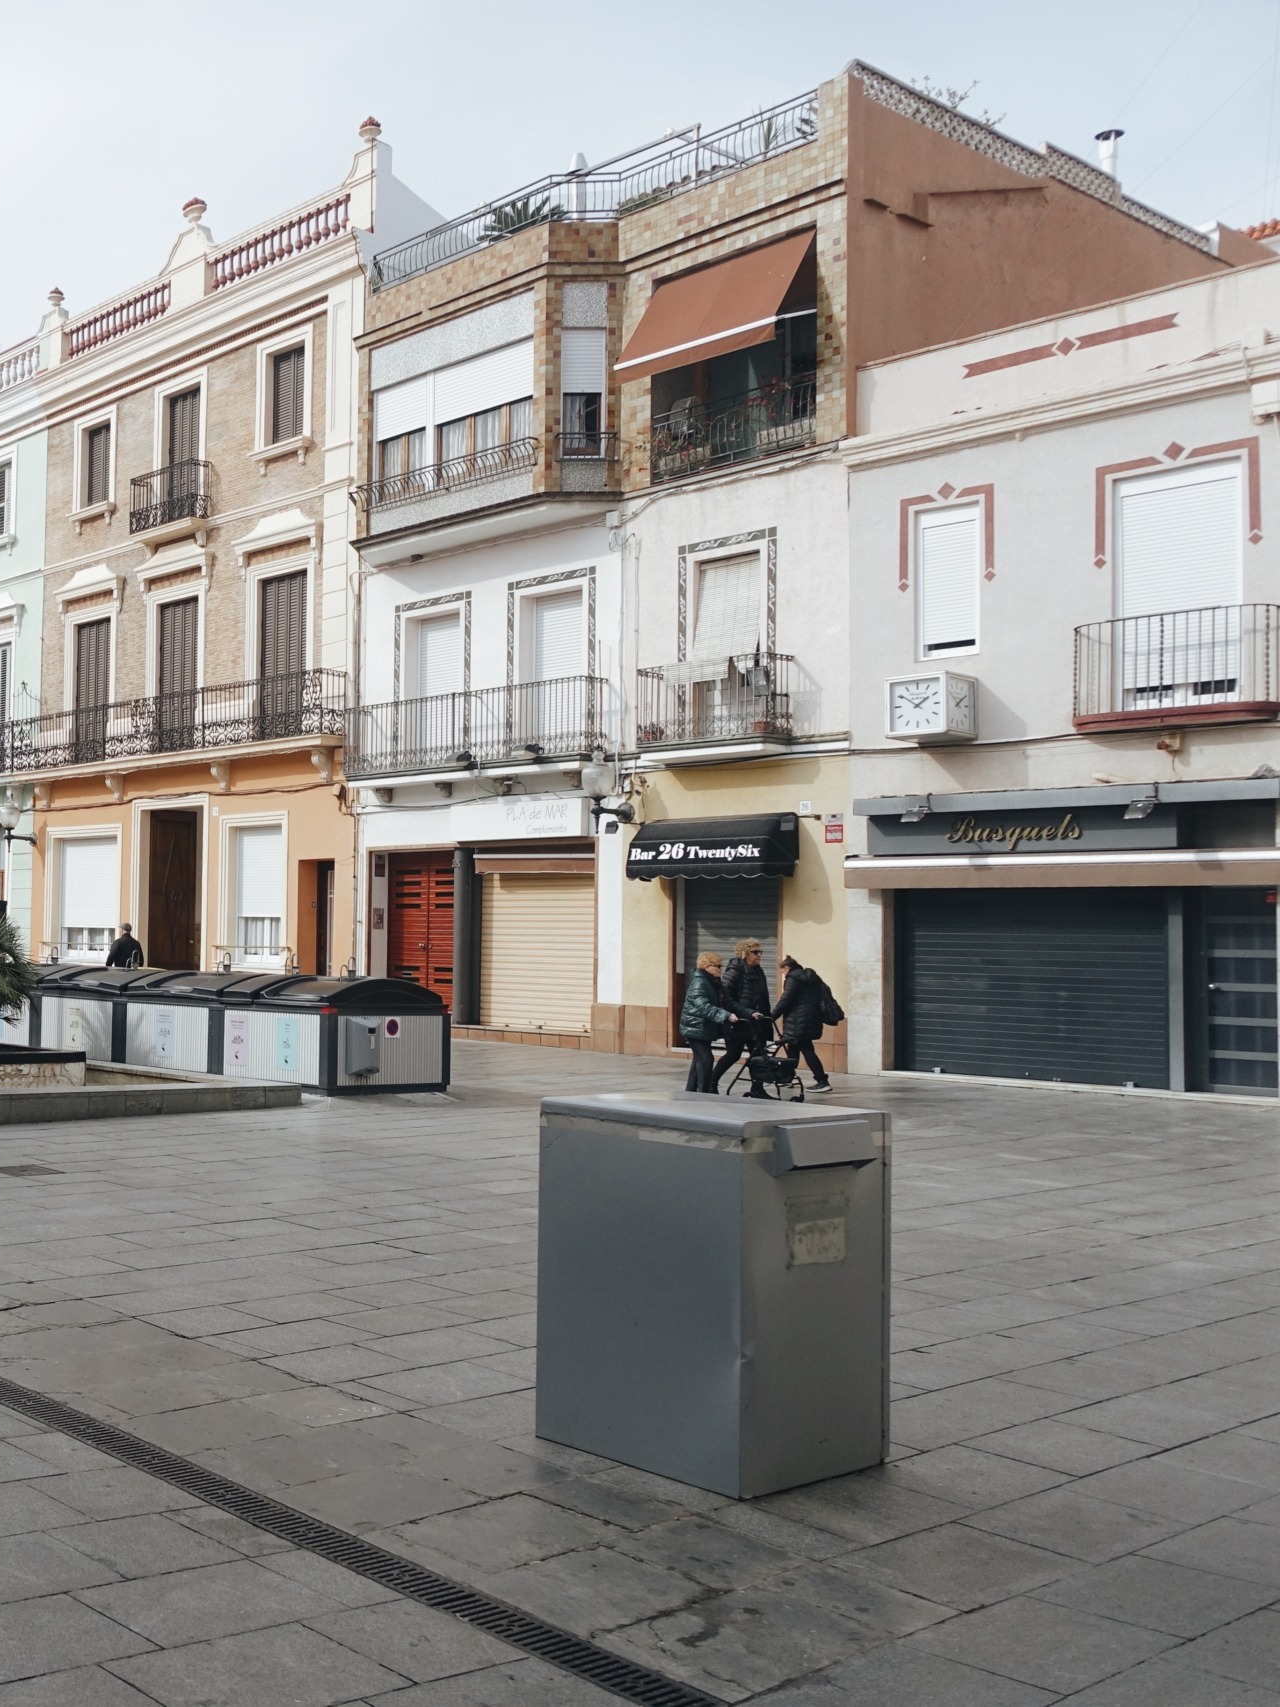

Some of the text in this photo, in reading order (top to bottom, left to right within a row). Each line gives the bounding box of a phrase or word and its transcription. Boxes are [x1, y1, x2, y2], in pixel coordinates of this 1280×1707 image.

[506, 803, 568, 821] PLA de MAR
[629, 843, 761, 862] Bar 26 TwentySix
